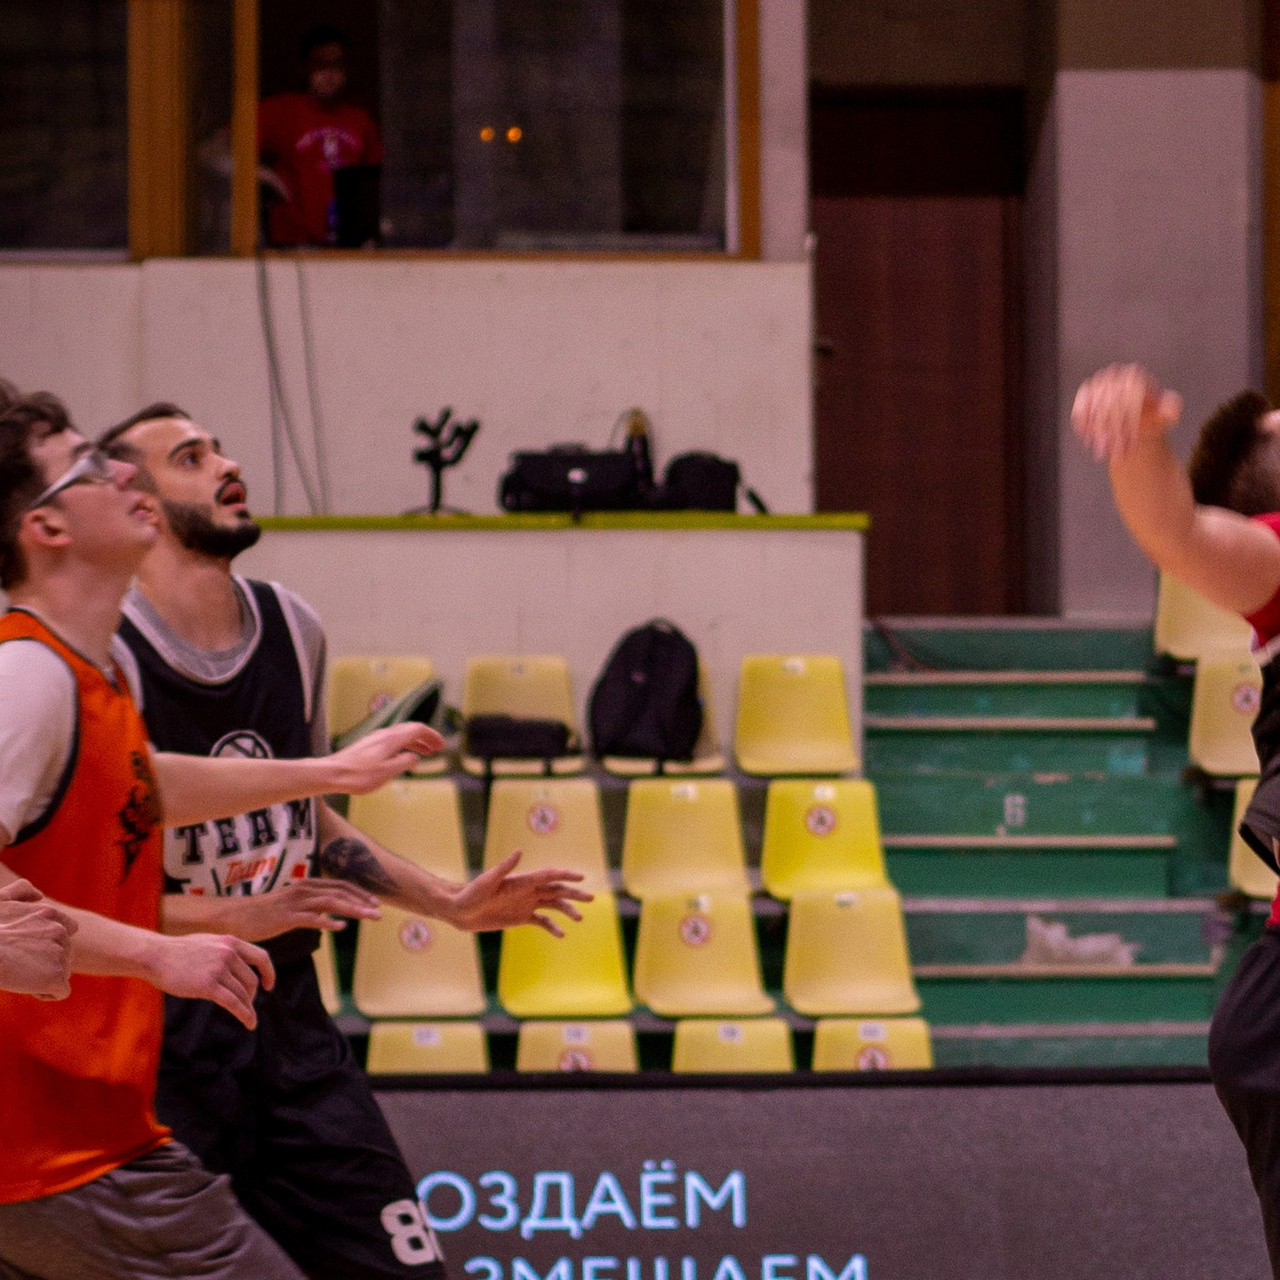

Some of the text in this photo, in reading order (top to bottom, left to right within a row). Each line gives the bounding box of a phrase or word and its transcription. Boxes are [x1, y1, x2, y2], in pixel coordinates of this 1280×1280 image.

[174, 797, 313, 865] TEAM
[381, 1199, 444, 1266] 8
[415, 1160, 747, 1241] ОЗДАЁМ
